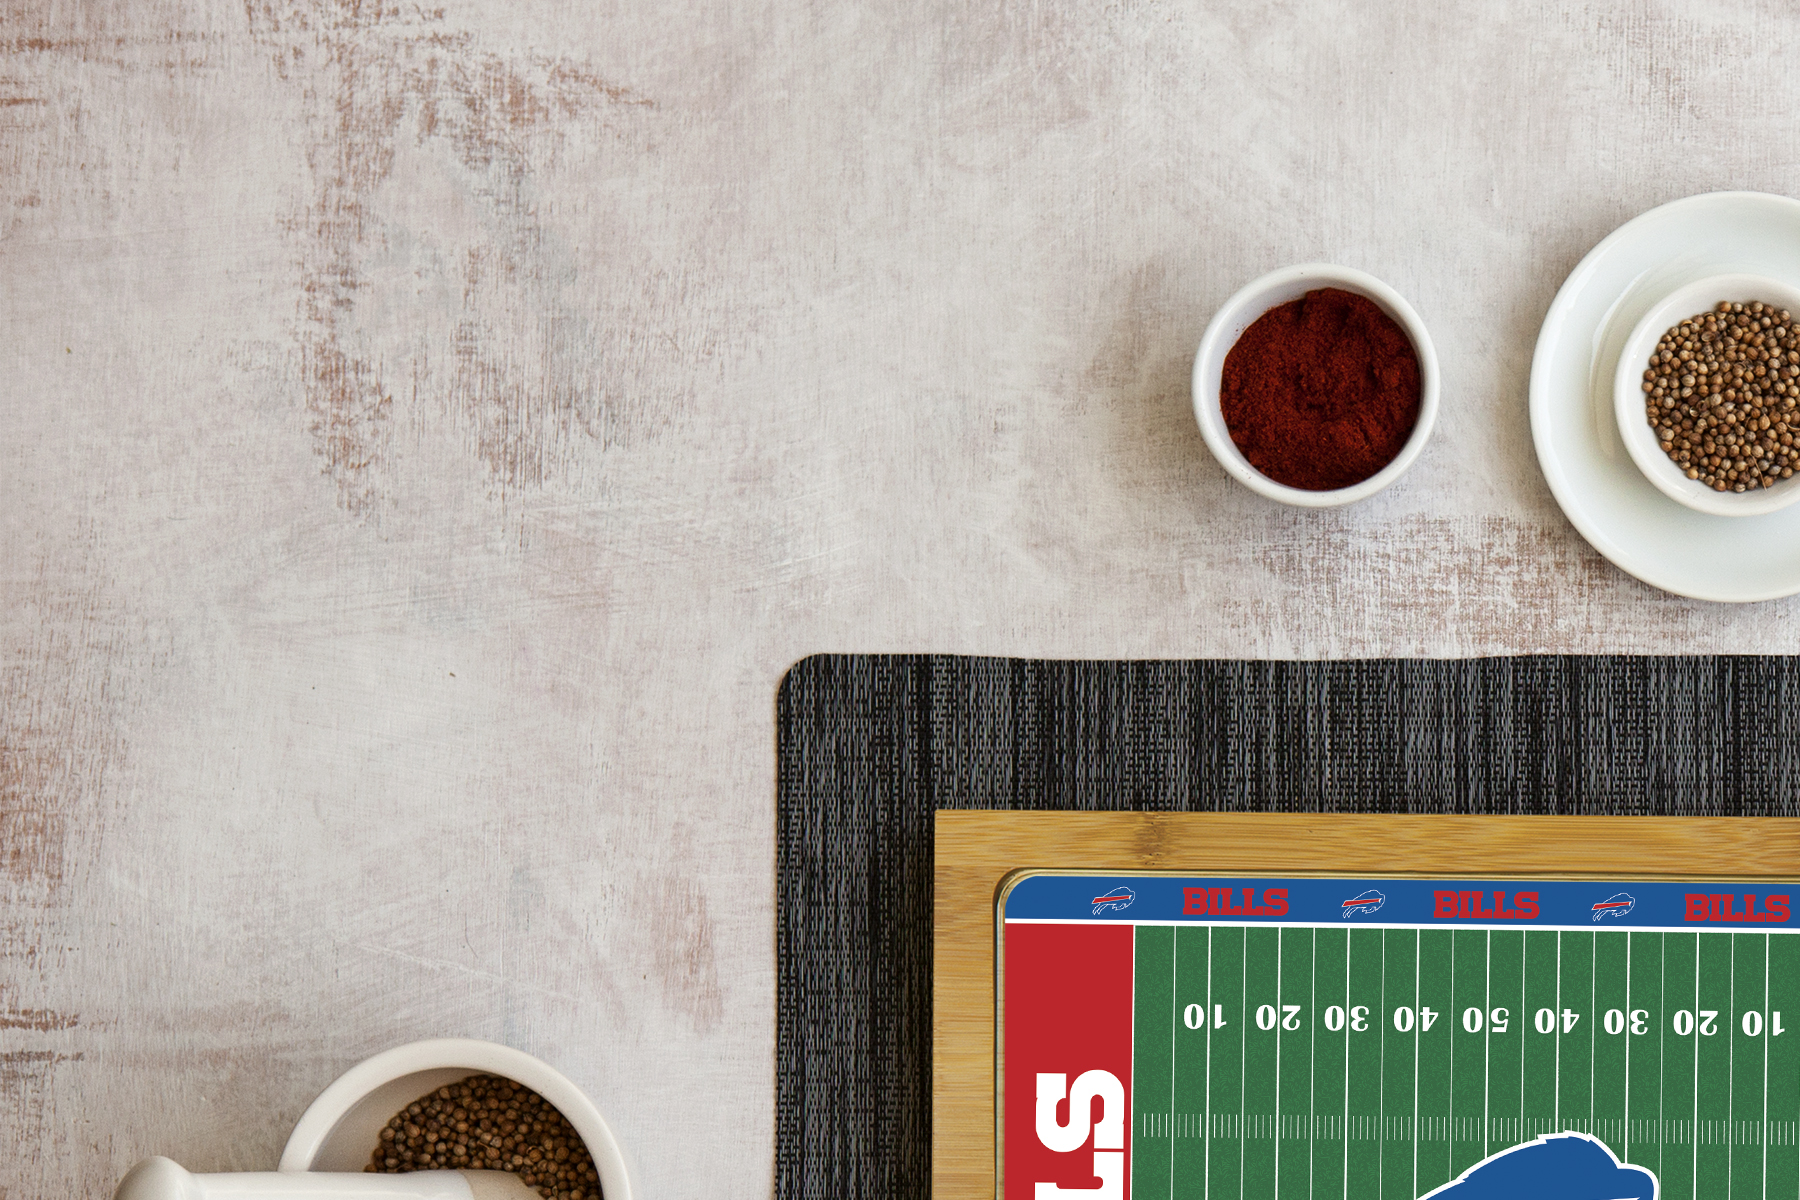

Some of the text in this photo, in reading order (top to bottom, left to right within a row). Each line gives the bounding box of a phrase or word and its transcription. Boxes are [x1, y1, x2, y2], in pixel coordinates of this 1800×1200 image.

[1183, 888, 1289, 917] BILLS
[1434, 891, 1540, 920] BILLS
[1685, 894, 1791, 923] BILLS
[1184, 1004, 1785, 1036] 10 20 30 40 50 40 30 20 10
